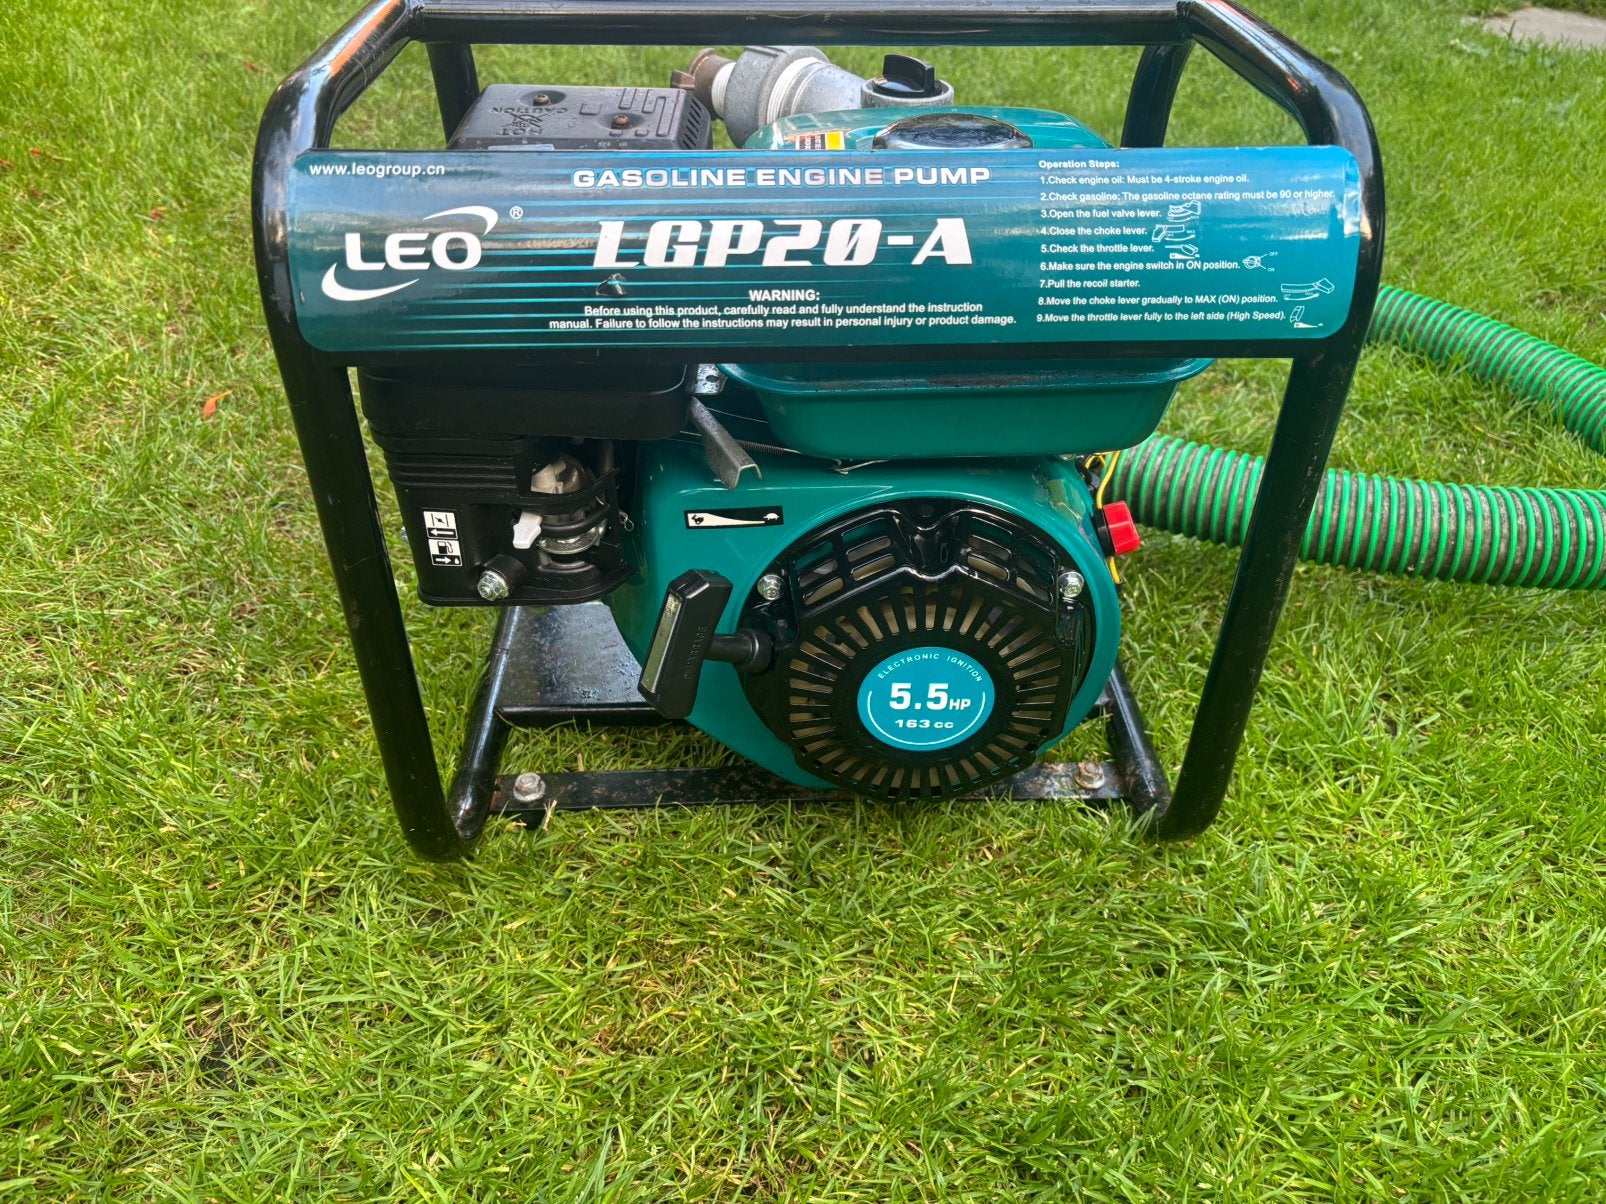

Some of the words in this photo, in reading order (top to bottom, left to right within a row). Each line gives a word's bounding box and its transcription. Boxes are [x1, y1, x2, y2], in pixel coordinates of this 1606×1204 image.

[491, 107, 568, 116] CAUTION
[309, 162, 445, 178] www.leogroup.cn
[1038, 160, 1087, 170] Operation
[1088, 160, 1120, 169] Steps:
[572, 168, 746, 188] GASOLINE
[755, 167, 884, 187] ENGINE
[898, 167, 991, 185] PUMP
[1040, 176, 1077, 184] 1.Check
[1079, 176, 1110, 186] engine
[1111, 175, 1125, 184] oil:
[1127, 175, 1149, 184] Must
[1151, 175, 1163, 184] be
[1164, 175, 1201, 183] 4-stroke
[1204, 174, 1234, 185] engine
[1236, 174, 1250, 183] oil.
[1040, 192, 1077, 201] 2.Check
[1079, 192, 1120, 202] gasoline:
[1122, 191, 1140, 200] The
[1142, 191, 1180, 202] gasoline
[1182, 192, 1212, 200] octane
[1214, 190, 1240, 201] rating
[1242, 191, 1264, 199] must
[1266, 190, 1278, 199] be
[1279, 190, 1291, 199] 90
[1305, 189, 1336, 200] higher.
[1041, 209, 1074, 219] 3.Open
[1076, 209, 1091, 218] the
[1092, 209, 1109, 218] fuel
[1111, 209, 1135, 217] valve
[1137, 209, 1162, 217] lever.
[1040, 226, 1076, 235] 4.Close
[1077, 226, 1092, 235] the
[1093, 226, 1121, 235] choke
[1122, 226, 1148, 235] lever.
[593, 218, 973, 268] LGP20-A
[1041, 244, 1078, 253] 5.Check
[1080, 243, 1095, 252] the
[1096, 243, 1128, 252] throttle
[1130, 243, 1155, 252] lever.
[345, 231, 482, 271] LEO
[1040, 262, 1073, 271] 6.Make
[1097, 261, 1112, 270] the
[1113, 261, 1144, 272] engine
[1146, 261, 1174, 270] switch
[1176, 261, 1184, 269] in
[1186, 261, 1201, 269] ON
[1203, 260, 1241, 271] position.
[1040, 279, 1065, 288] 7.Pull
[1067, 279, 1081, 288] the
[1083, 278, 1108, 288] recoil
[1109, 279, 1141, 287] starter.
[749, 289, 820, 301] WARNING:
[1038, 296, 1071, 305] 8.Move
[1072, 296, 1087, 305] the
[1089, 296, 1116, 305] choke
[1117, 296, 1140, 304] lever
[1141, 295, 1183, 306] gradually
[1195, 295, 1217, 303] MAX
[1218, 294, 1240, 304] (ON)
[1241, 293, 1278, 304] position.
[584, 305, 620, 316] Before
[623, 305, 653, 317] using
[655, 305, 675, 315] this
[677, 305, 721, 317] product,
[723, 304, 769, 317] carefully
[772, 304, 797, 314] read
[798, 304, 819, 314] and
[821, 303, 844, 316] fully
[846, 303, 906, 314] understand
[908, 302, 925, 313] the
[928, 302, 983, 312] instruction
[549, 319, 593, 329] manual.
[595, 319, 633, 329] Failure
[635, 319, 646, 328] to
[649, 318, 680, 328] follow
[682, 318, 700, 328] the
[702, 317, 764, 328] instructions
[766, 319, 789, 329] may
[791, 317, 821, 327] result
[823, 317, 833, 327] in
[836, 316, 882, 328] personal
[884, 315, 913, 328] injury
[915, 317, 927, 326] or
[929, 315, 969, 327] product
[971, 315, 1017, 326] damage.
[1036, 313, 1069, 322] 9.Move
[1071, 313, 1085, 321] the
[1087, 313, 1118, 321] throttle
[1120, 313, 1143, 321] lever
[1144, 312, 1162, 322] fully
[1175, 312, 1189, 320] the
[1191, 312, 1205, 320] left
[1206, 311, 1225, 320] side
[1226, 311, 1250, 322] (High
[1252, 310, 1286, 321] Speed).
[877, 653, 940, 679] ELECTRONIC
[947, 655, 982, 682] IGNITION
[894, 719, 930, 729] 163
[933, 721, 954, 729] cc
